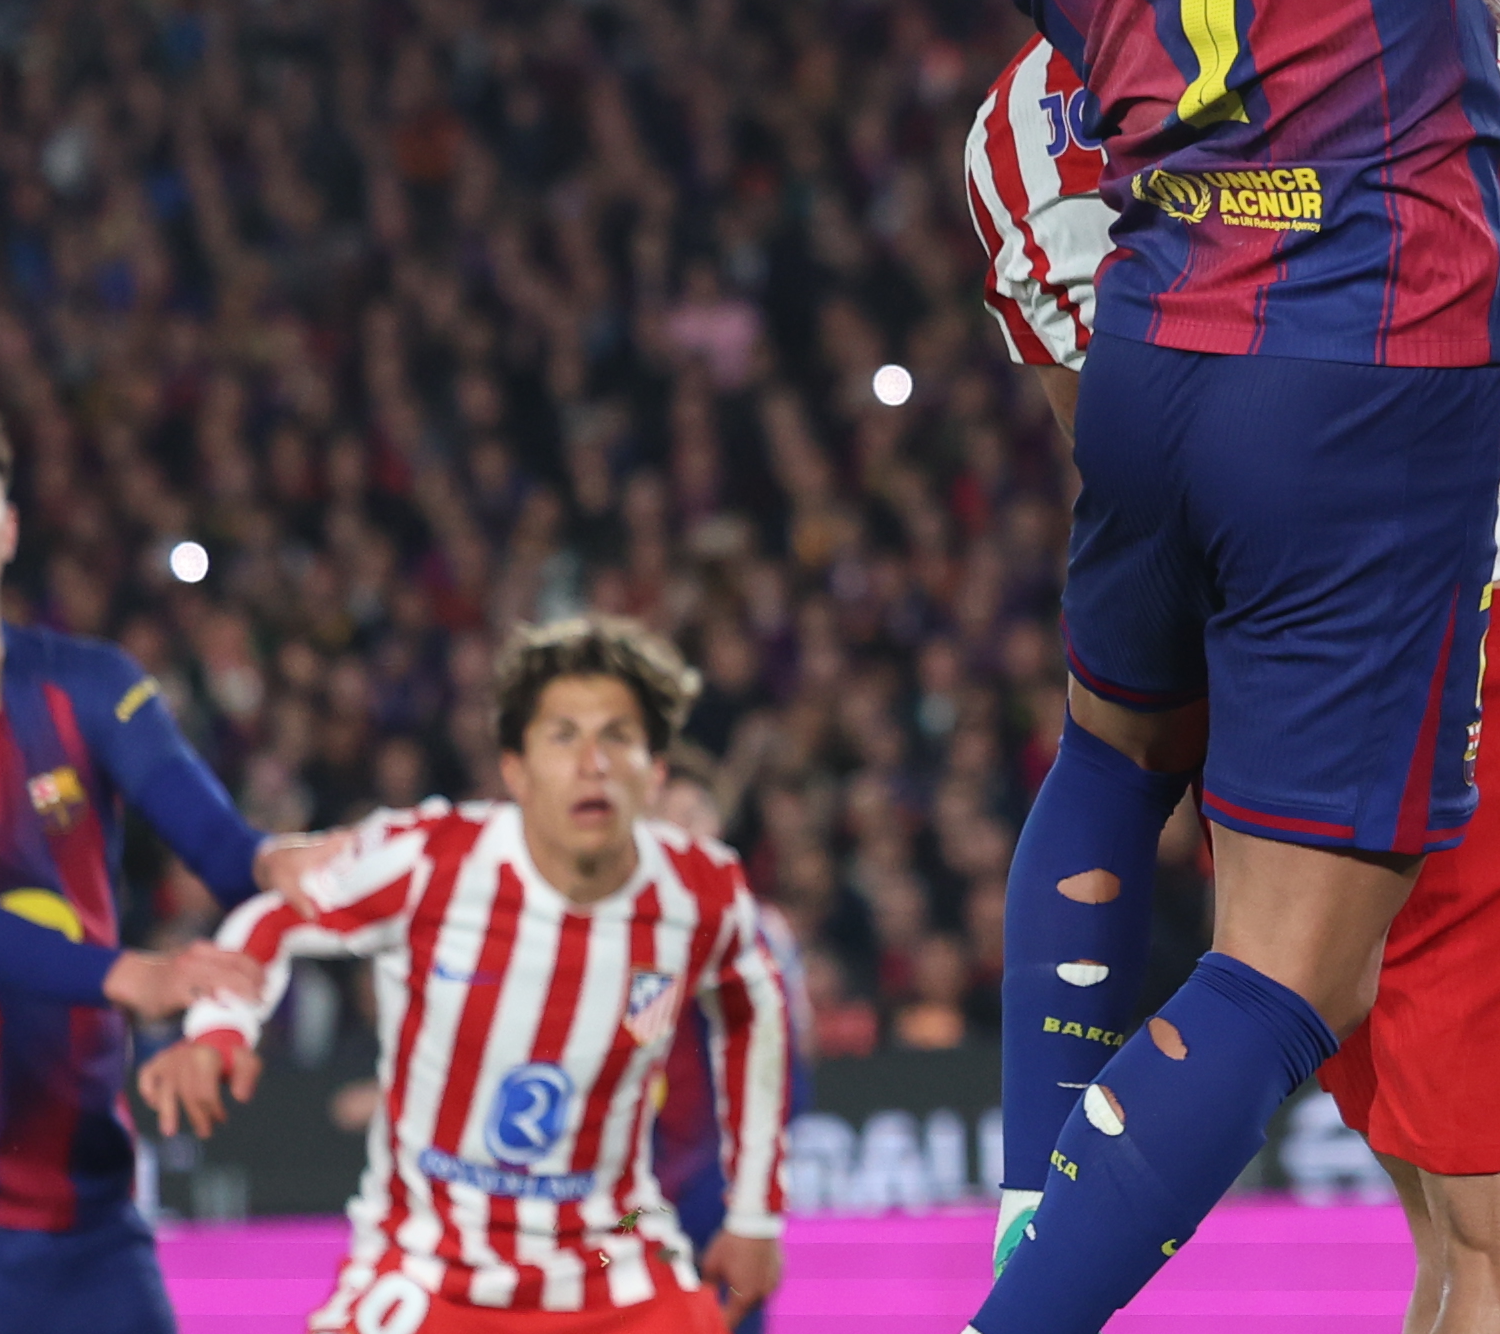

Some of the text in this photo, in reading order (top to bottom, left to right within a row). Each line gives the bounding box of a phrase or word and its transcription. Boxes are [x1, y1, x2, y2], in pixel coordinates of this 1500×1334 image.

[1202, 167, 1321, 191] UNHCR
[1219, 189, 1322, 219] ACNUR
[1221, 214, 1321, 233] The UN Refugee Agency
[1043, 1016, 1125, 1047] BARÇA
